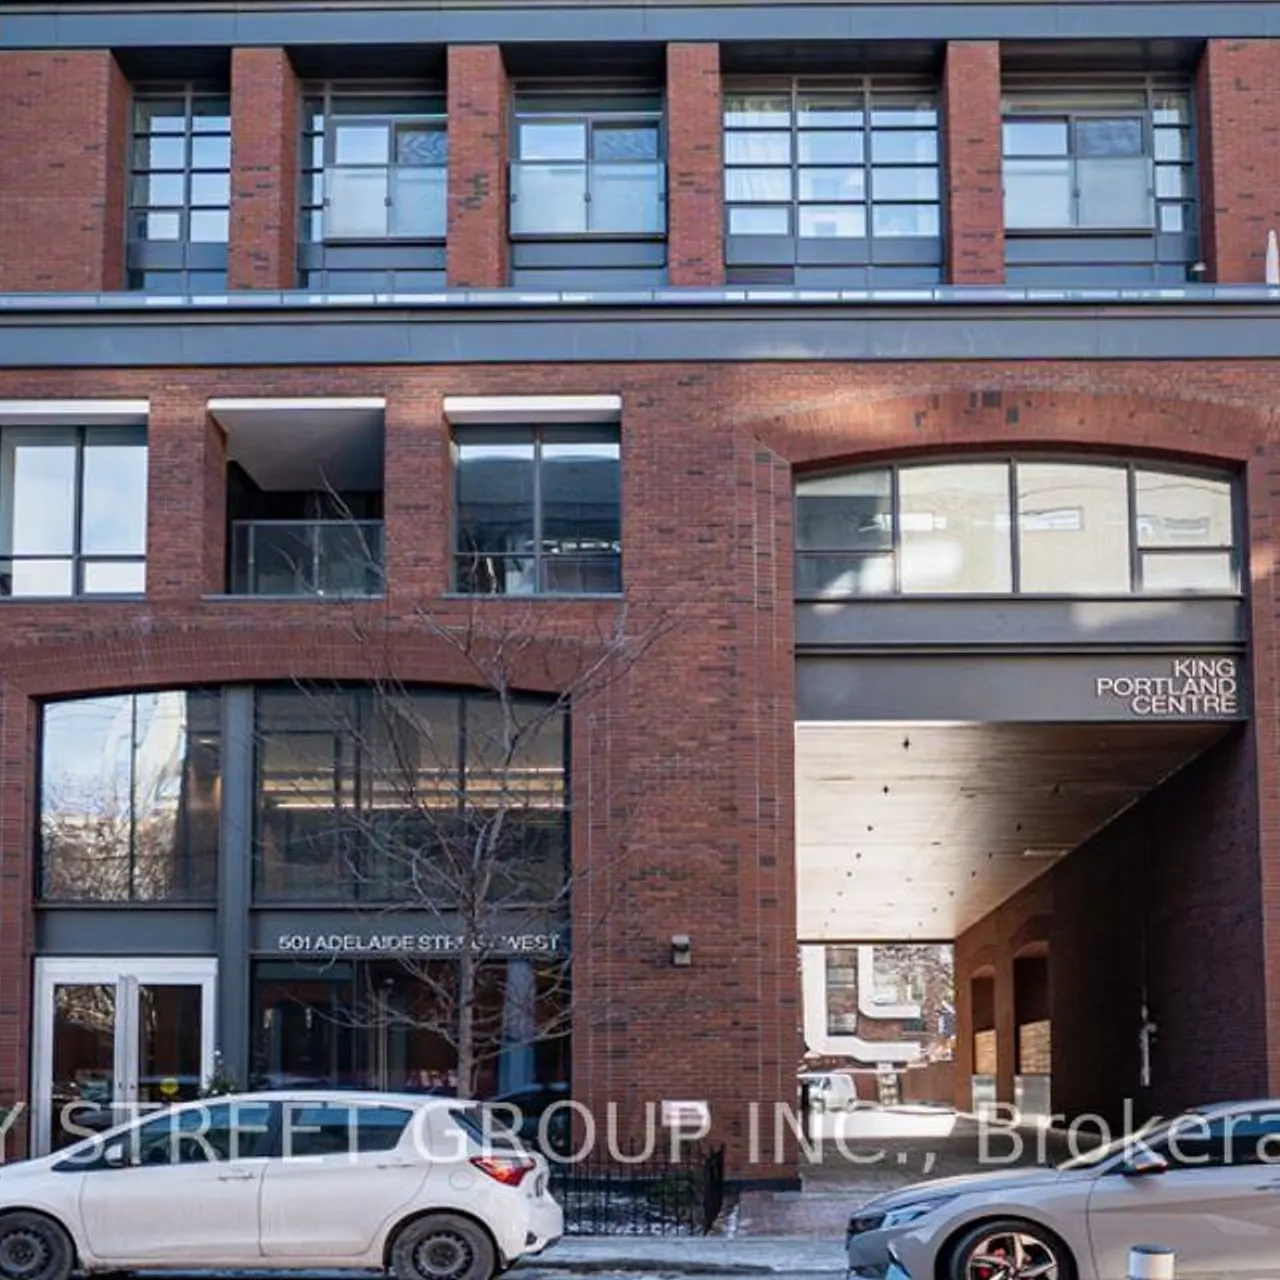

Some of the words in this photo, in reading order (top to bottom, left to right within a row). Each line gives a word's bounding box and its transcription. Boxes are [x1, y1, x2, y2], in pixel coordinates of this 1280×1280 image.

[1174, 658, 1236, 678] KING
[1097, 677, 1237, 696] PORTLAND
[1131, 695, 1237, 714] CENTRE
[279, 935, 311, 951] 501
[315, 935, 415, 950] ADELAIDE
[501, 934, 560, 950] WEST
